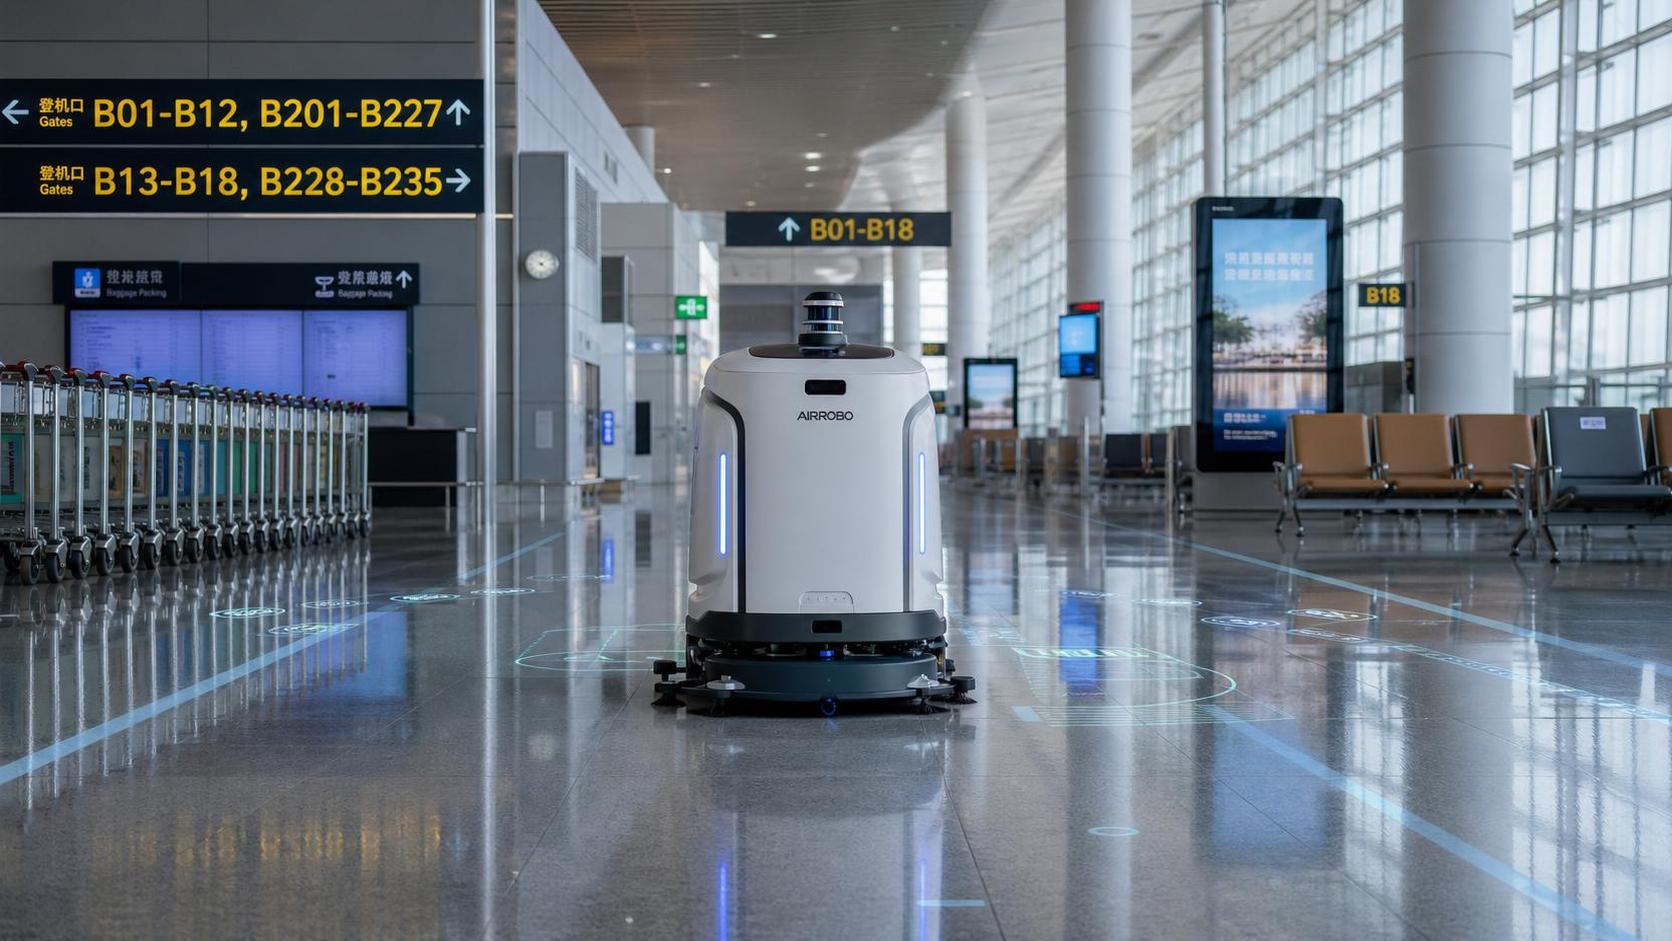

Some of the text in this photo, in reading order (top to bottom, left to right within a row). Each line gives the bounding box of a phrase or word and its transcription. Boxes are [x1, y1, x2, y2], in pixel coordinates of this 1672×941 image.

[39, 97, 84, 113] 登机口
[39, 115, 73, 128] Gates
[93, 98, 443, 132] B01-B12, B201-B227
[39, 165, 85, 182] 登机口
[39, 183, 73, 196] Gates
[94, 167, 443, 200] B13-B18, B228-B235
[810, 218, 914, 241] B01-B18
[1366, 286, 1401, 304] B18
[797, 411, 854, 421] AIRROBO
